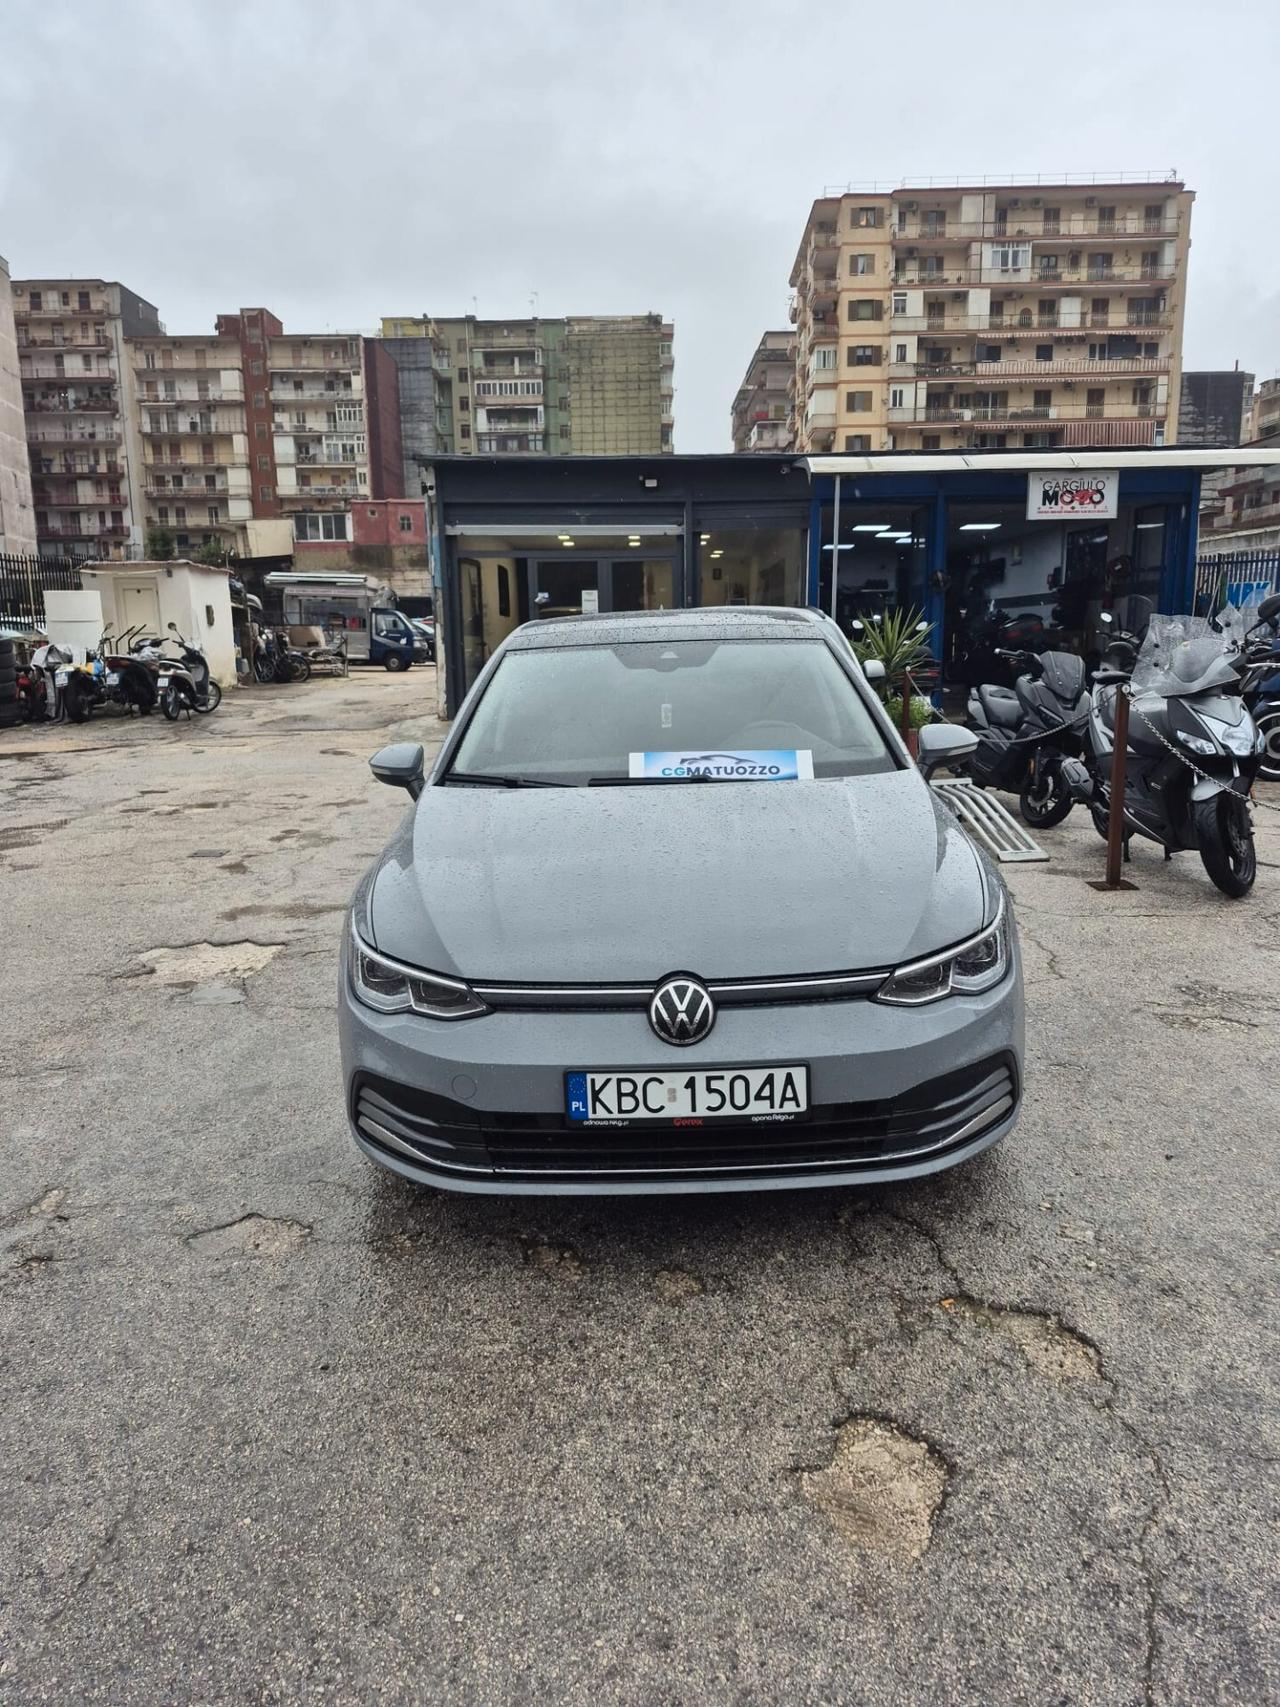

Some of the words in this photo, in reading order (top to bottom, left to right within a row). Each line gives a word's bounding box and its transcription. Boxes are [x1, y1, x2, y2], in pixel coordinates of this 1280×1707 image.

[1043, 480, 1106, 491] GARGIULO
[662, 765, 780, 776] CGMATUOZZO
[591, 1077, 665, 1114] KBC
[684, 1072, 800, 1112] 1504A
[572, 1102, 585, 1112] PL
